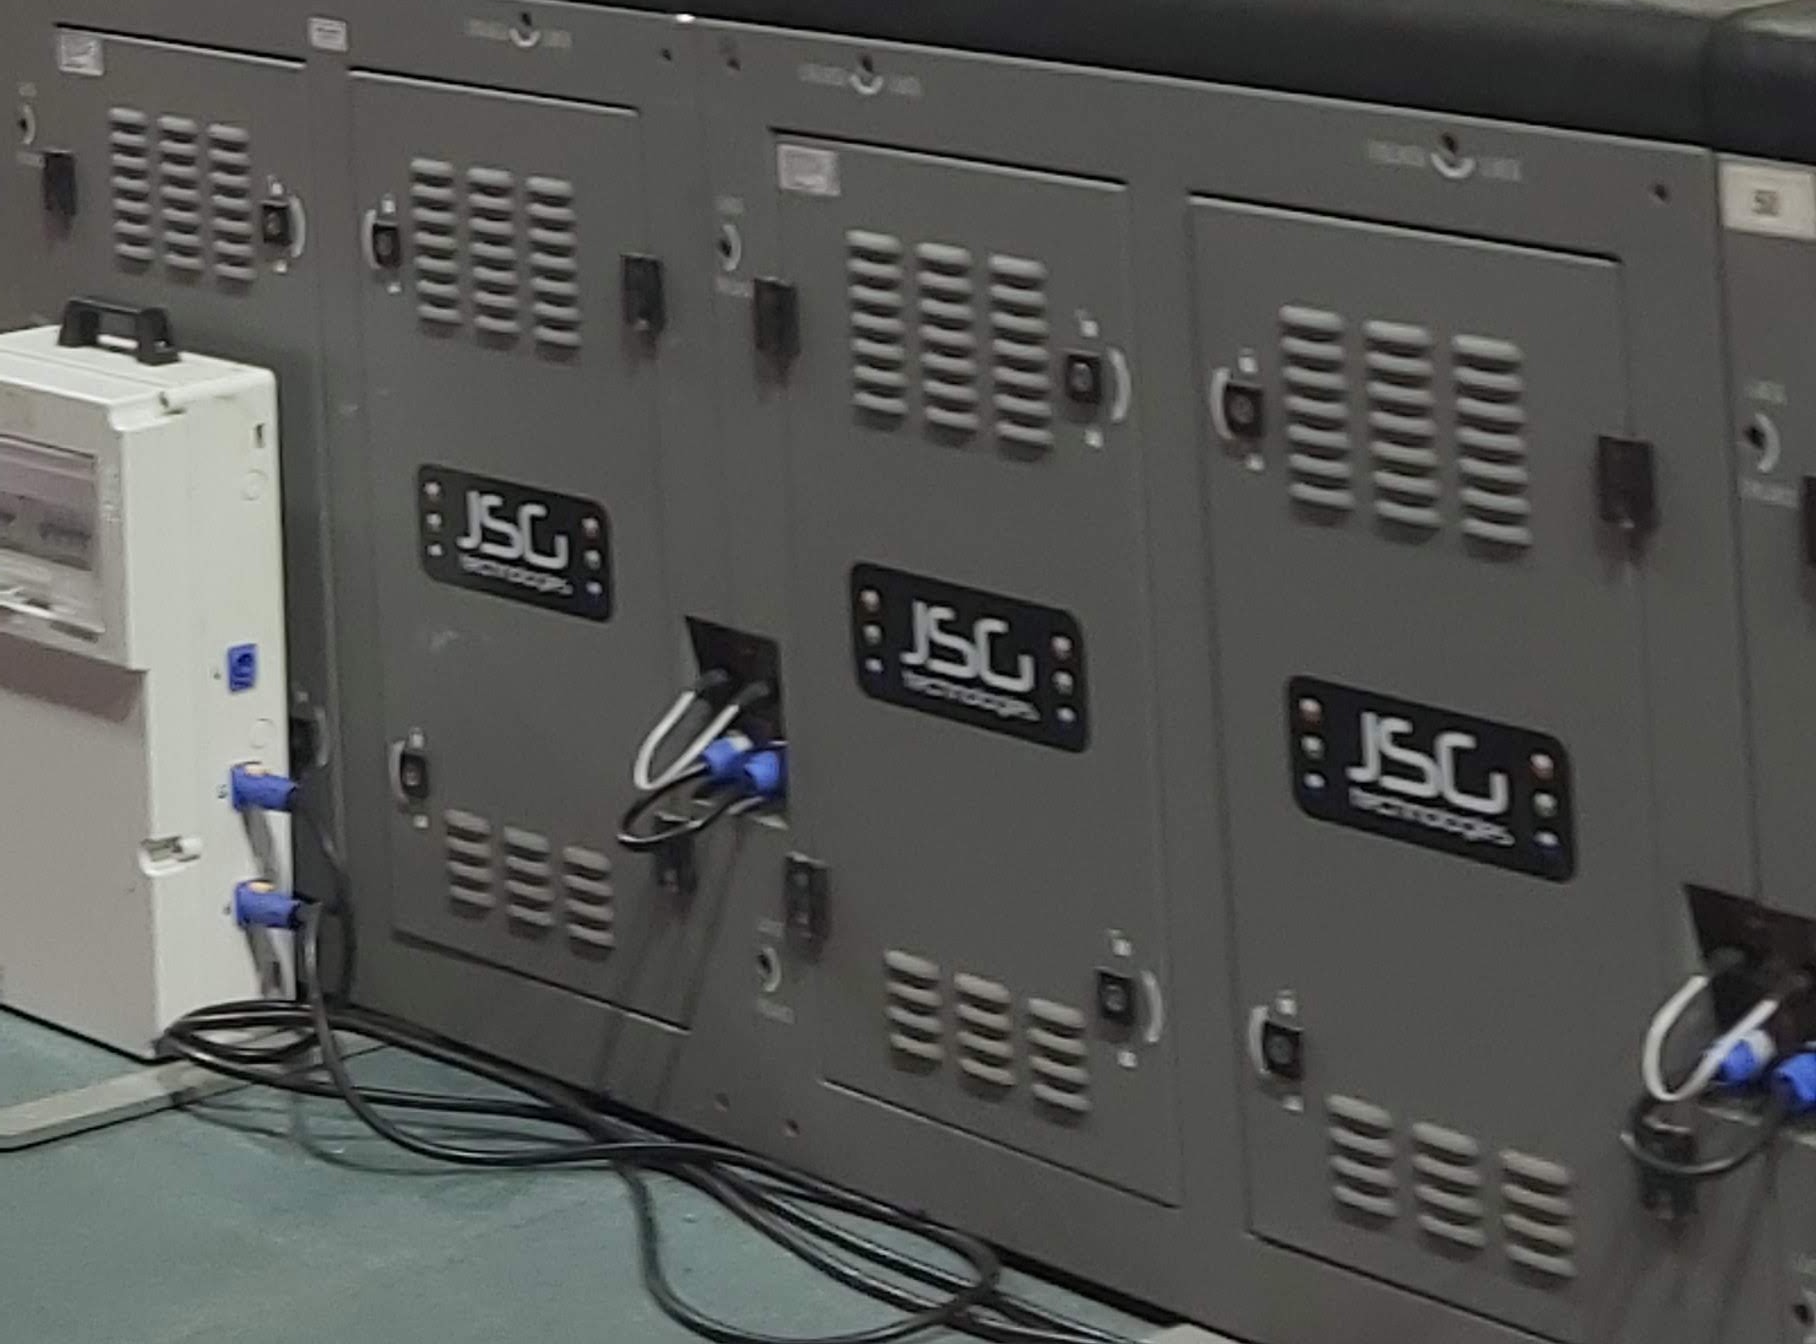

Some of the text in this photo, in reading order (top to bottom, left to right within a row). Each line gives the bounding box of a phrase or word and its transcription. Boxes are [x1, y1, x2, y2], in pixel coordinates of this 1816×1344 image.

[456, 490, 569, 570] JSG
[900, 598, 1036, 694] JSG
[1345, 711, 1509, 815] JSG
